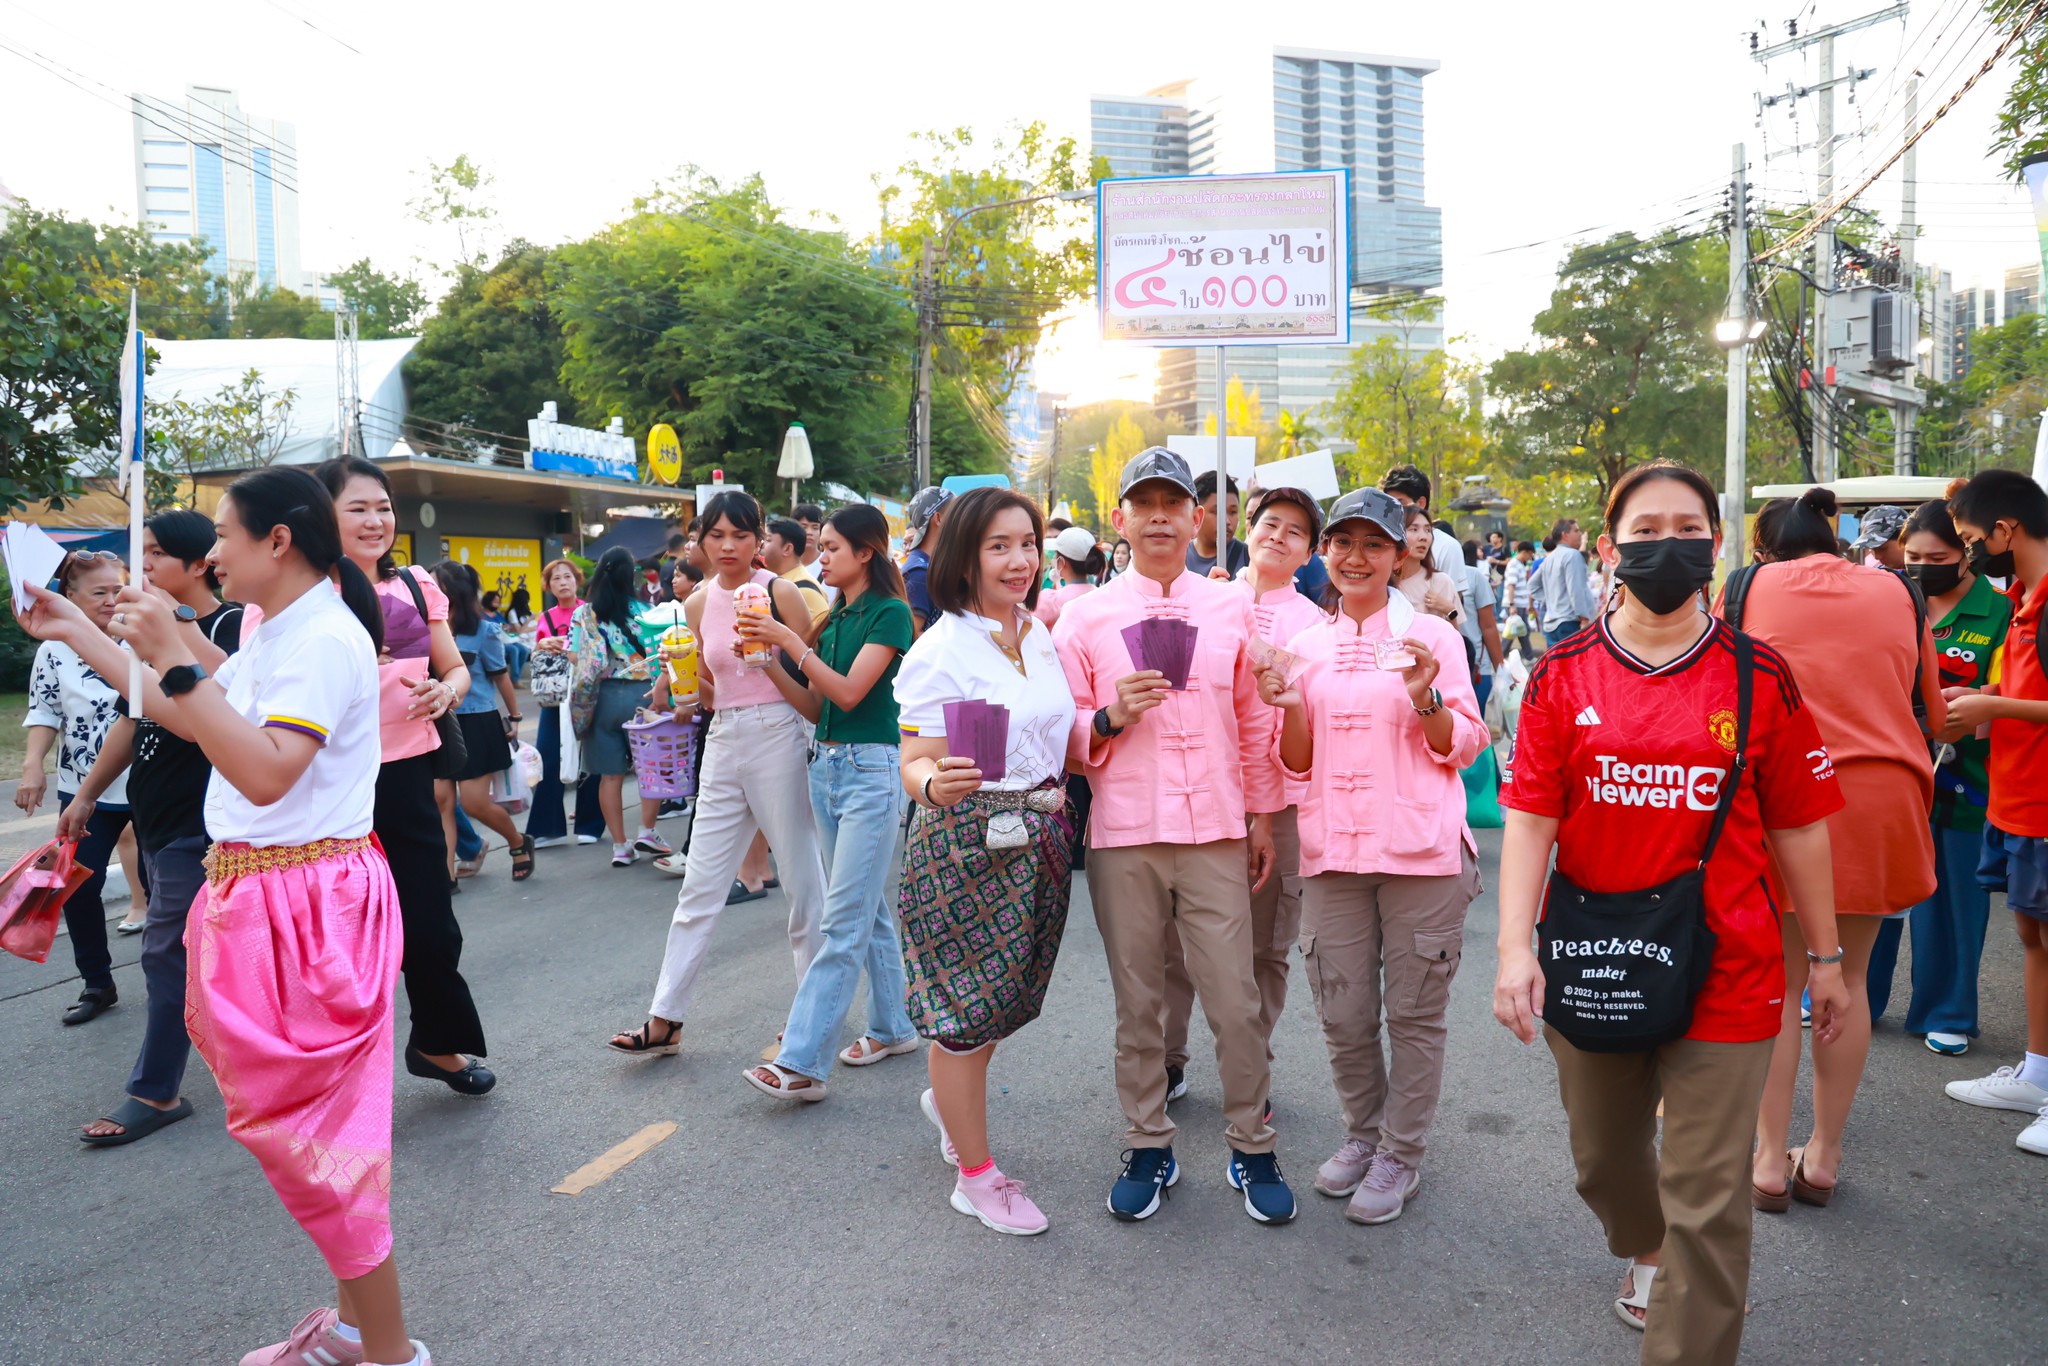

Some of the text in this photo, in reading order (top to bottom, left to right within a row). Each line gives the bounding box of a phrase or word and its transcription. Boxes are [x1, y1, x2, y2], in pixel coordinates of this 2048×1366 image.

[1112, 186, 1326, 207] ร้านสำนักงานปลัดกระทรวงกลาโหม
[1178, 233, 1325, 267] ช้อนไข่
[1114, 248, 1326, 309] ๔ ใบ ๑๐๐ บาท
[1956, 629, 1991, 646] X KAWS
[1595, 755, 1685, 786] Team
[1581, 965, 1627, 981] maket
[1611, 990, 1643, 998] maket.
[1576, 1000, 1601, 1009] RIGHTS
[1576, 1011, 1595, 1019] made
[1598, 1013, 1607, 1021] by
